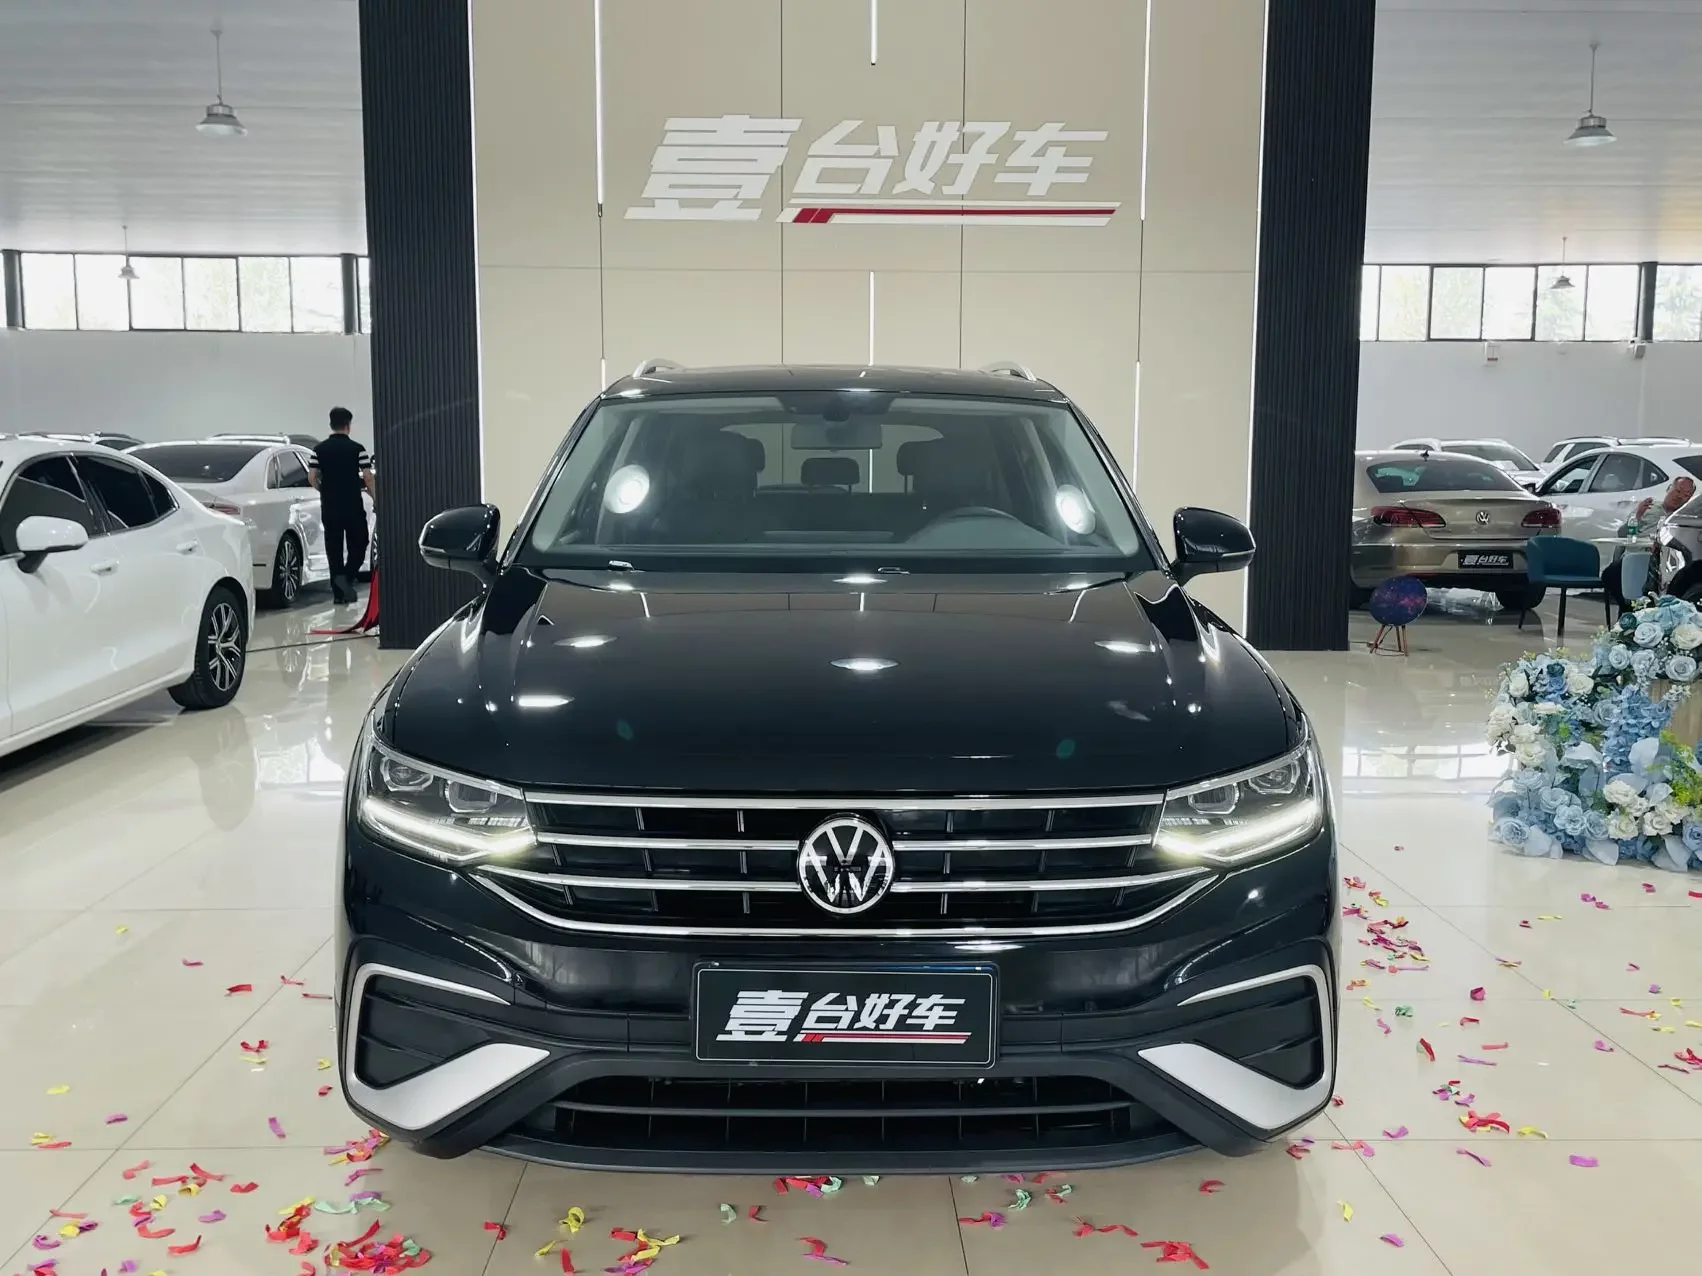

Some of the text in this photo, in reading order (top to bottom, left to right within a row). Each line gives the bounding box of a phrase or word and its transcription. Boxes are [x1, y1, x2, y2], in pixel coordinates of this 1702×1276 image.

[624, 114, 1109, 221] 壹台好车
[716, 990, 966, 1042] 壹台好车
